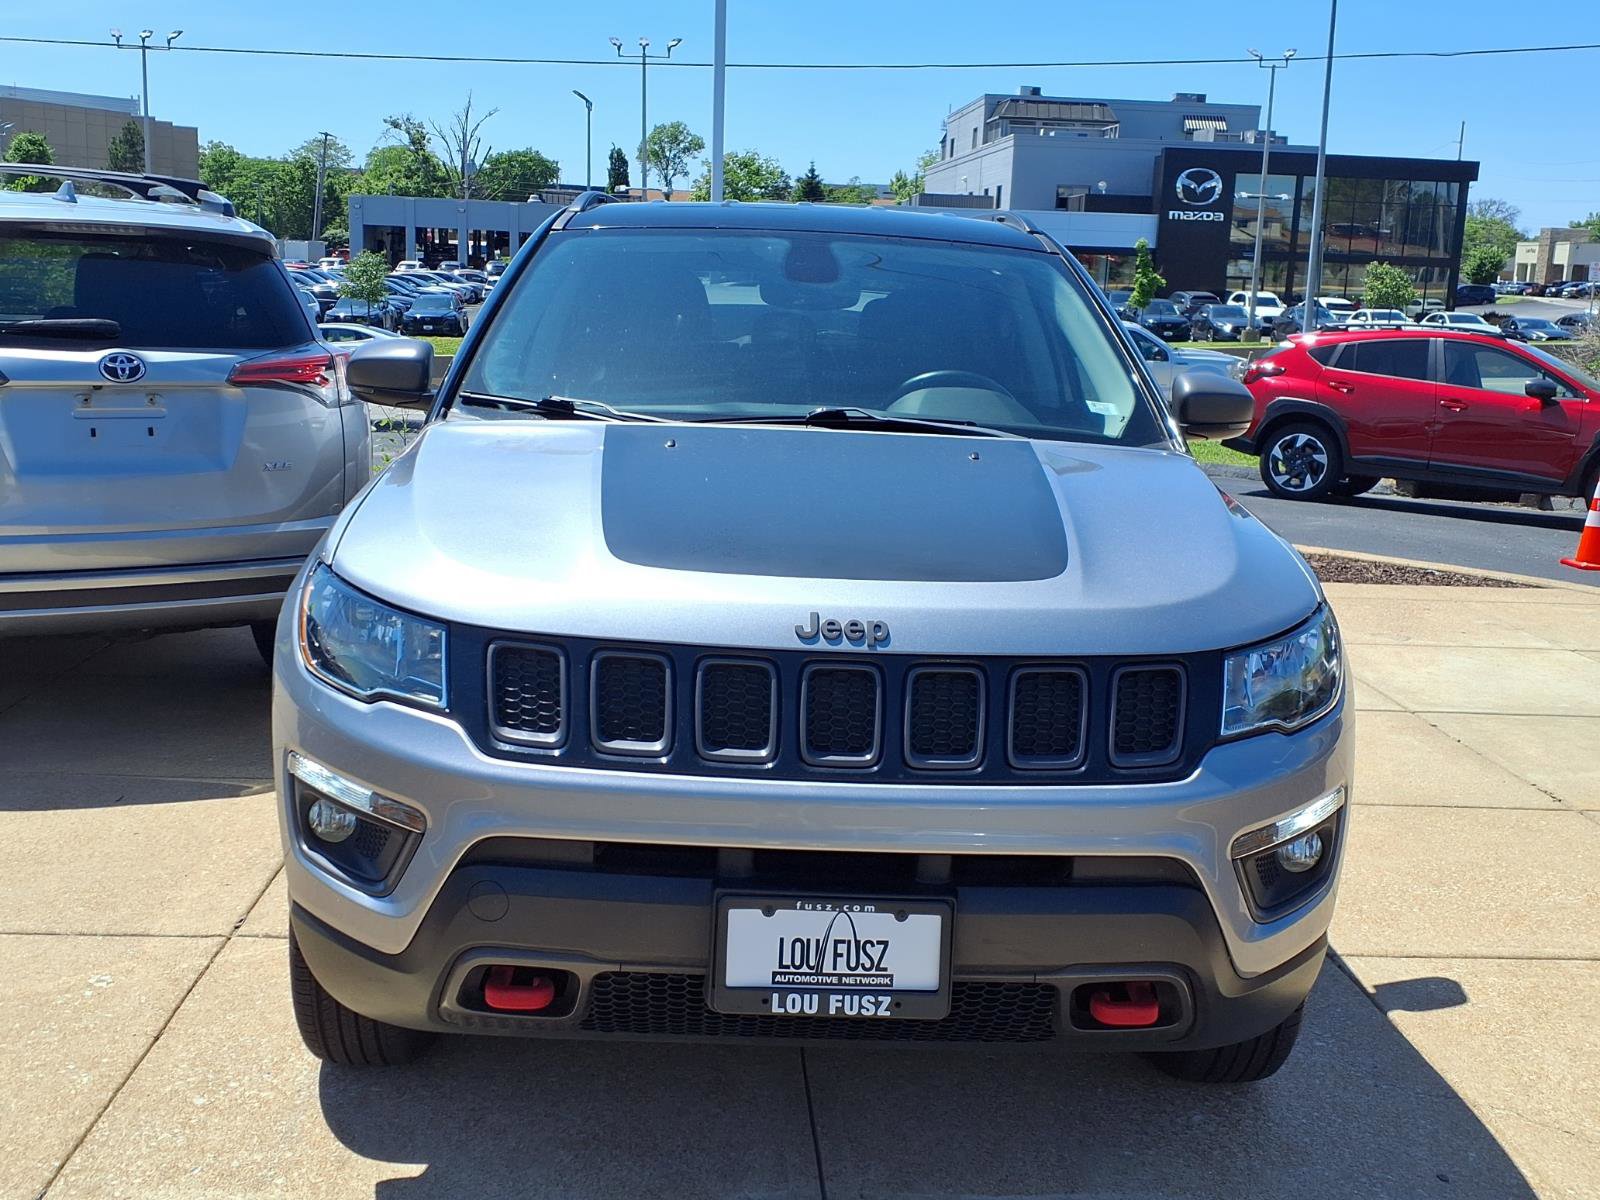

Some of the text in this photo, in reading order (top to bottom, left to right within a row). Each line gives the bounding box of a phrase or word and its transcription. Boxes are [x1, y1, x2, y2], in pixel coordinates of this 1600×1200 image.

[1168, 210, 1225, 222] mazda
[795, 611, 891, 649] Jeep
[796, 901, 876, 912] fusz.com
[778, 937, 890, 972] LOU FUSZ
[774, 974, 891, 985] AUTOMOTIVE NETWORK
[771, 993, 892, 1016] LOU FUSZ
